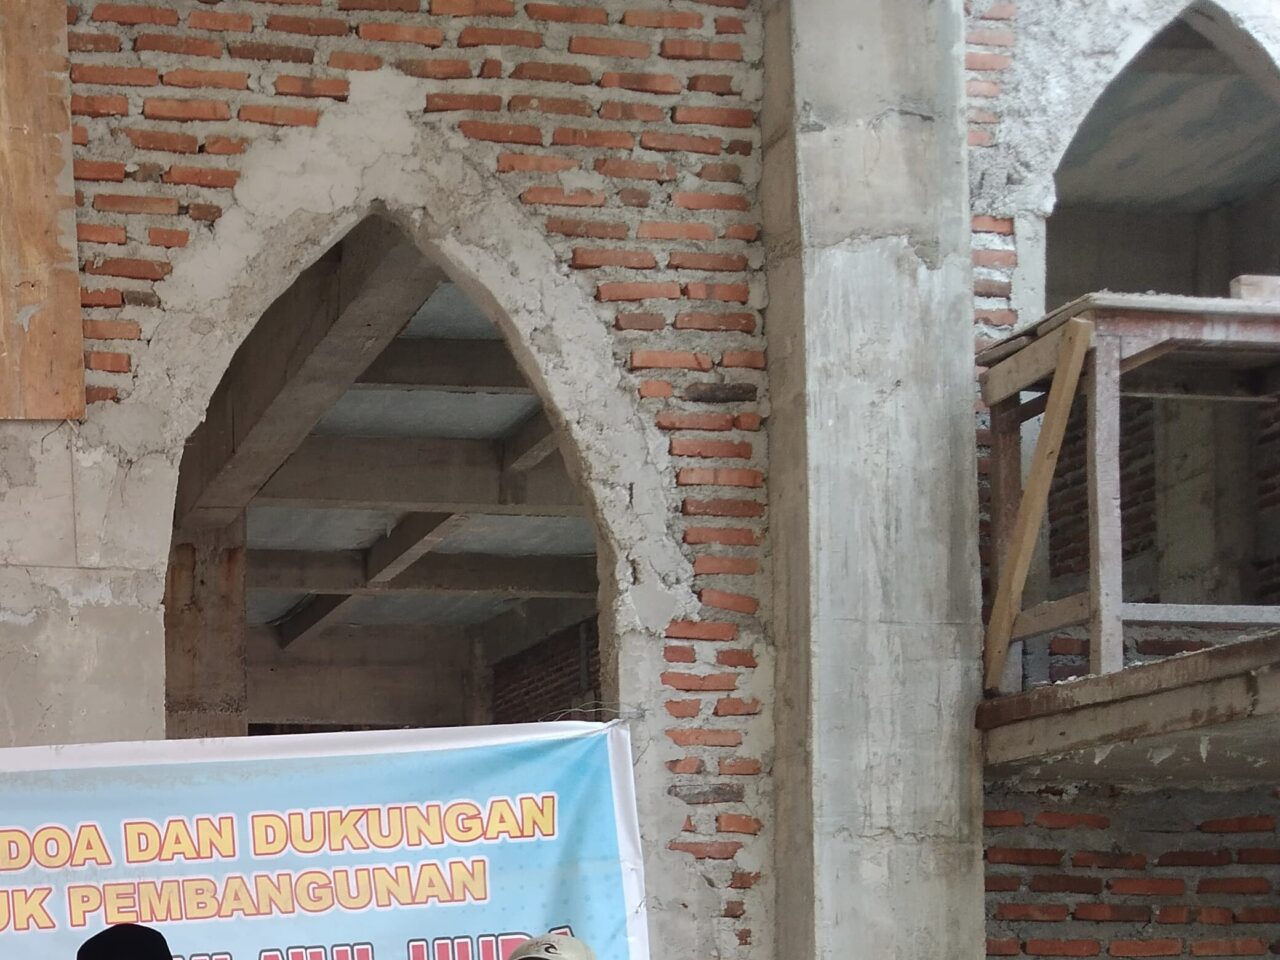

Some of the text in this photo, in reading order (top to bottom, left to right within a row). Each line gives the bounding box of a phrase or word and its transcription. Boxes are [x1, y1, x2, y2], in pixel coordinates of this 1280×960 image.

[124, 816, 236, 863] DAN
[252, 795, 556, 856] DUKUNGAN
[69, 859, 489, 927] PEMBANGUNAN
